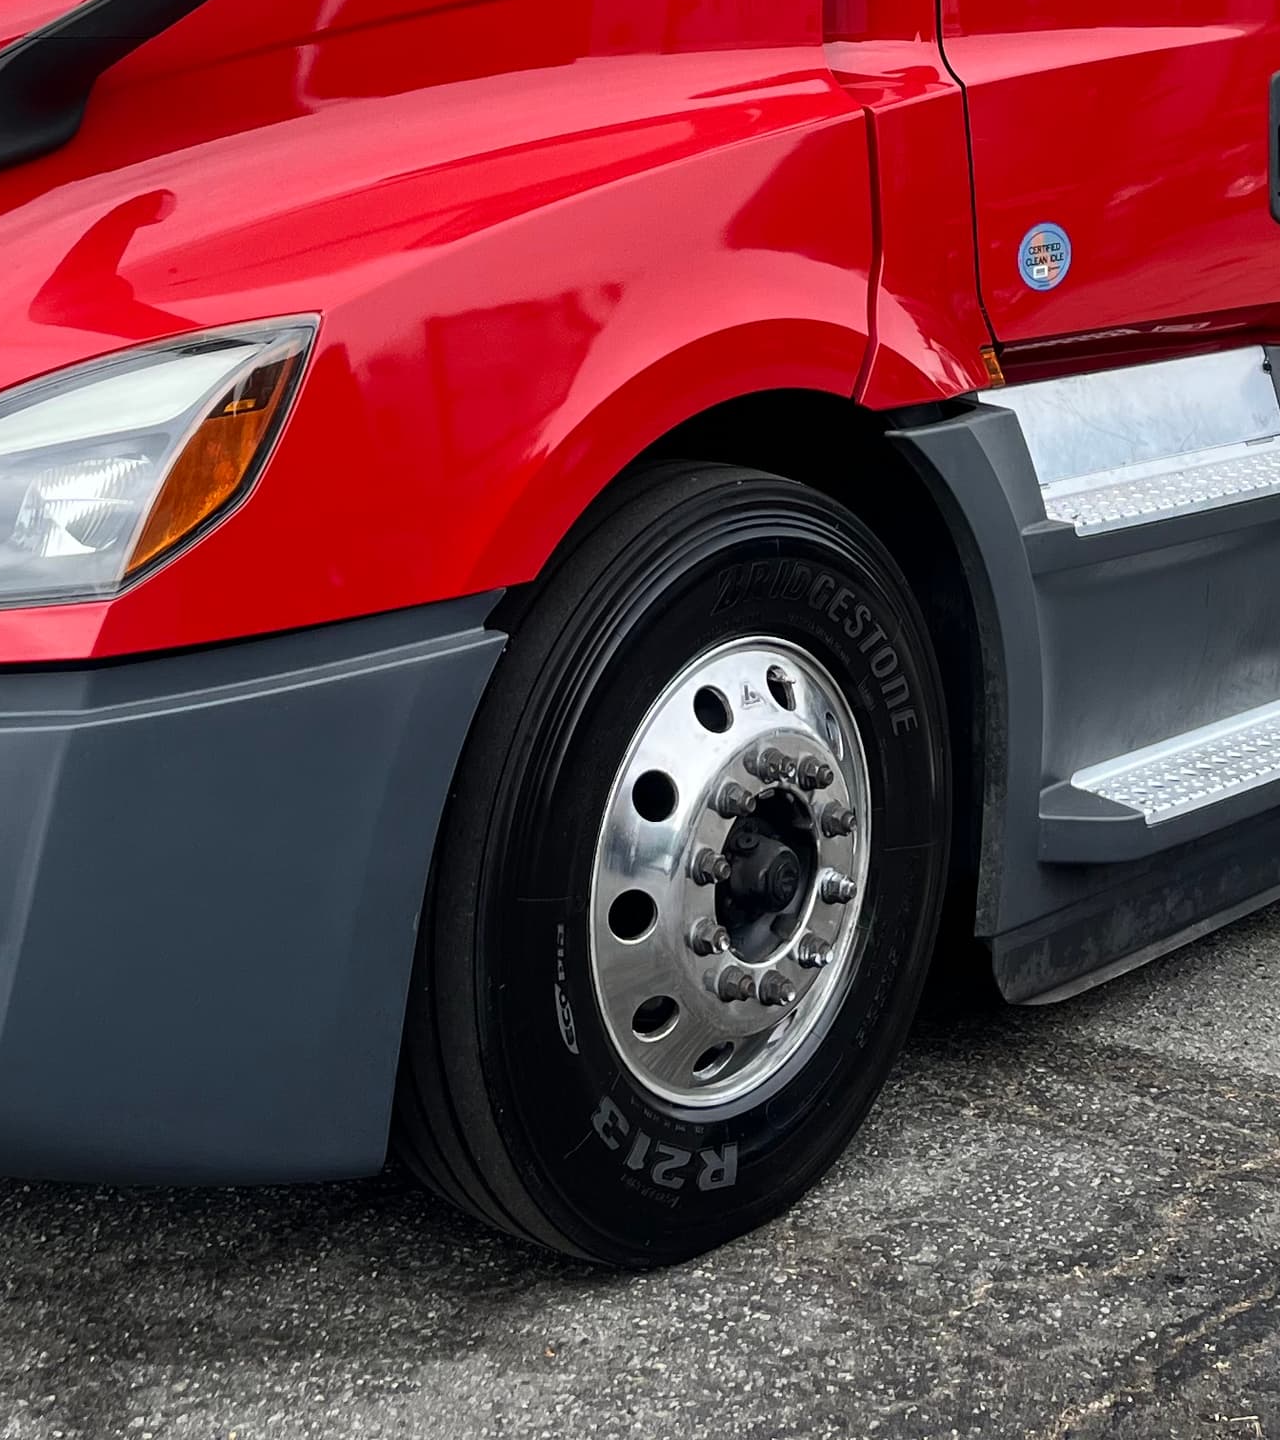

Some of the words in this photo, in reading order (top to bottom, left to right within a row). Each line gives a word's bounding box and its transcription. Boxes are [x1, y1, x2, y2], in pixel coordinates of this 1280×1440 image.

[1025, 256, 1048, 267] CLEAN
[1050, 252, 1064, 263] IDLE
[1028, 242, 1061, 255] CERTIFIED
[709, 558, 919, 737] BRIDGESTONE
[591, 1095, 739, 1192] R213
